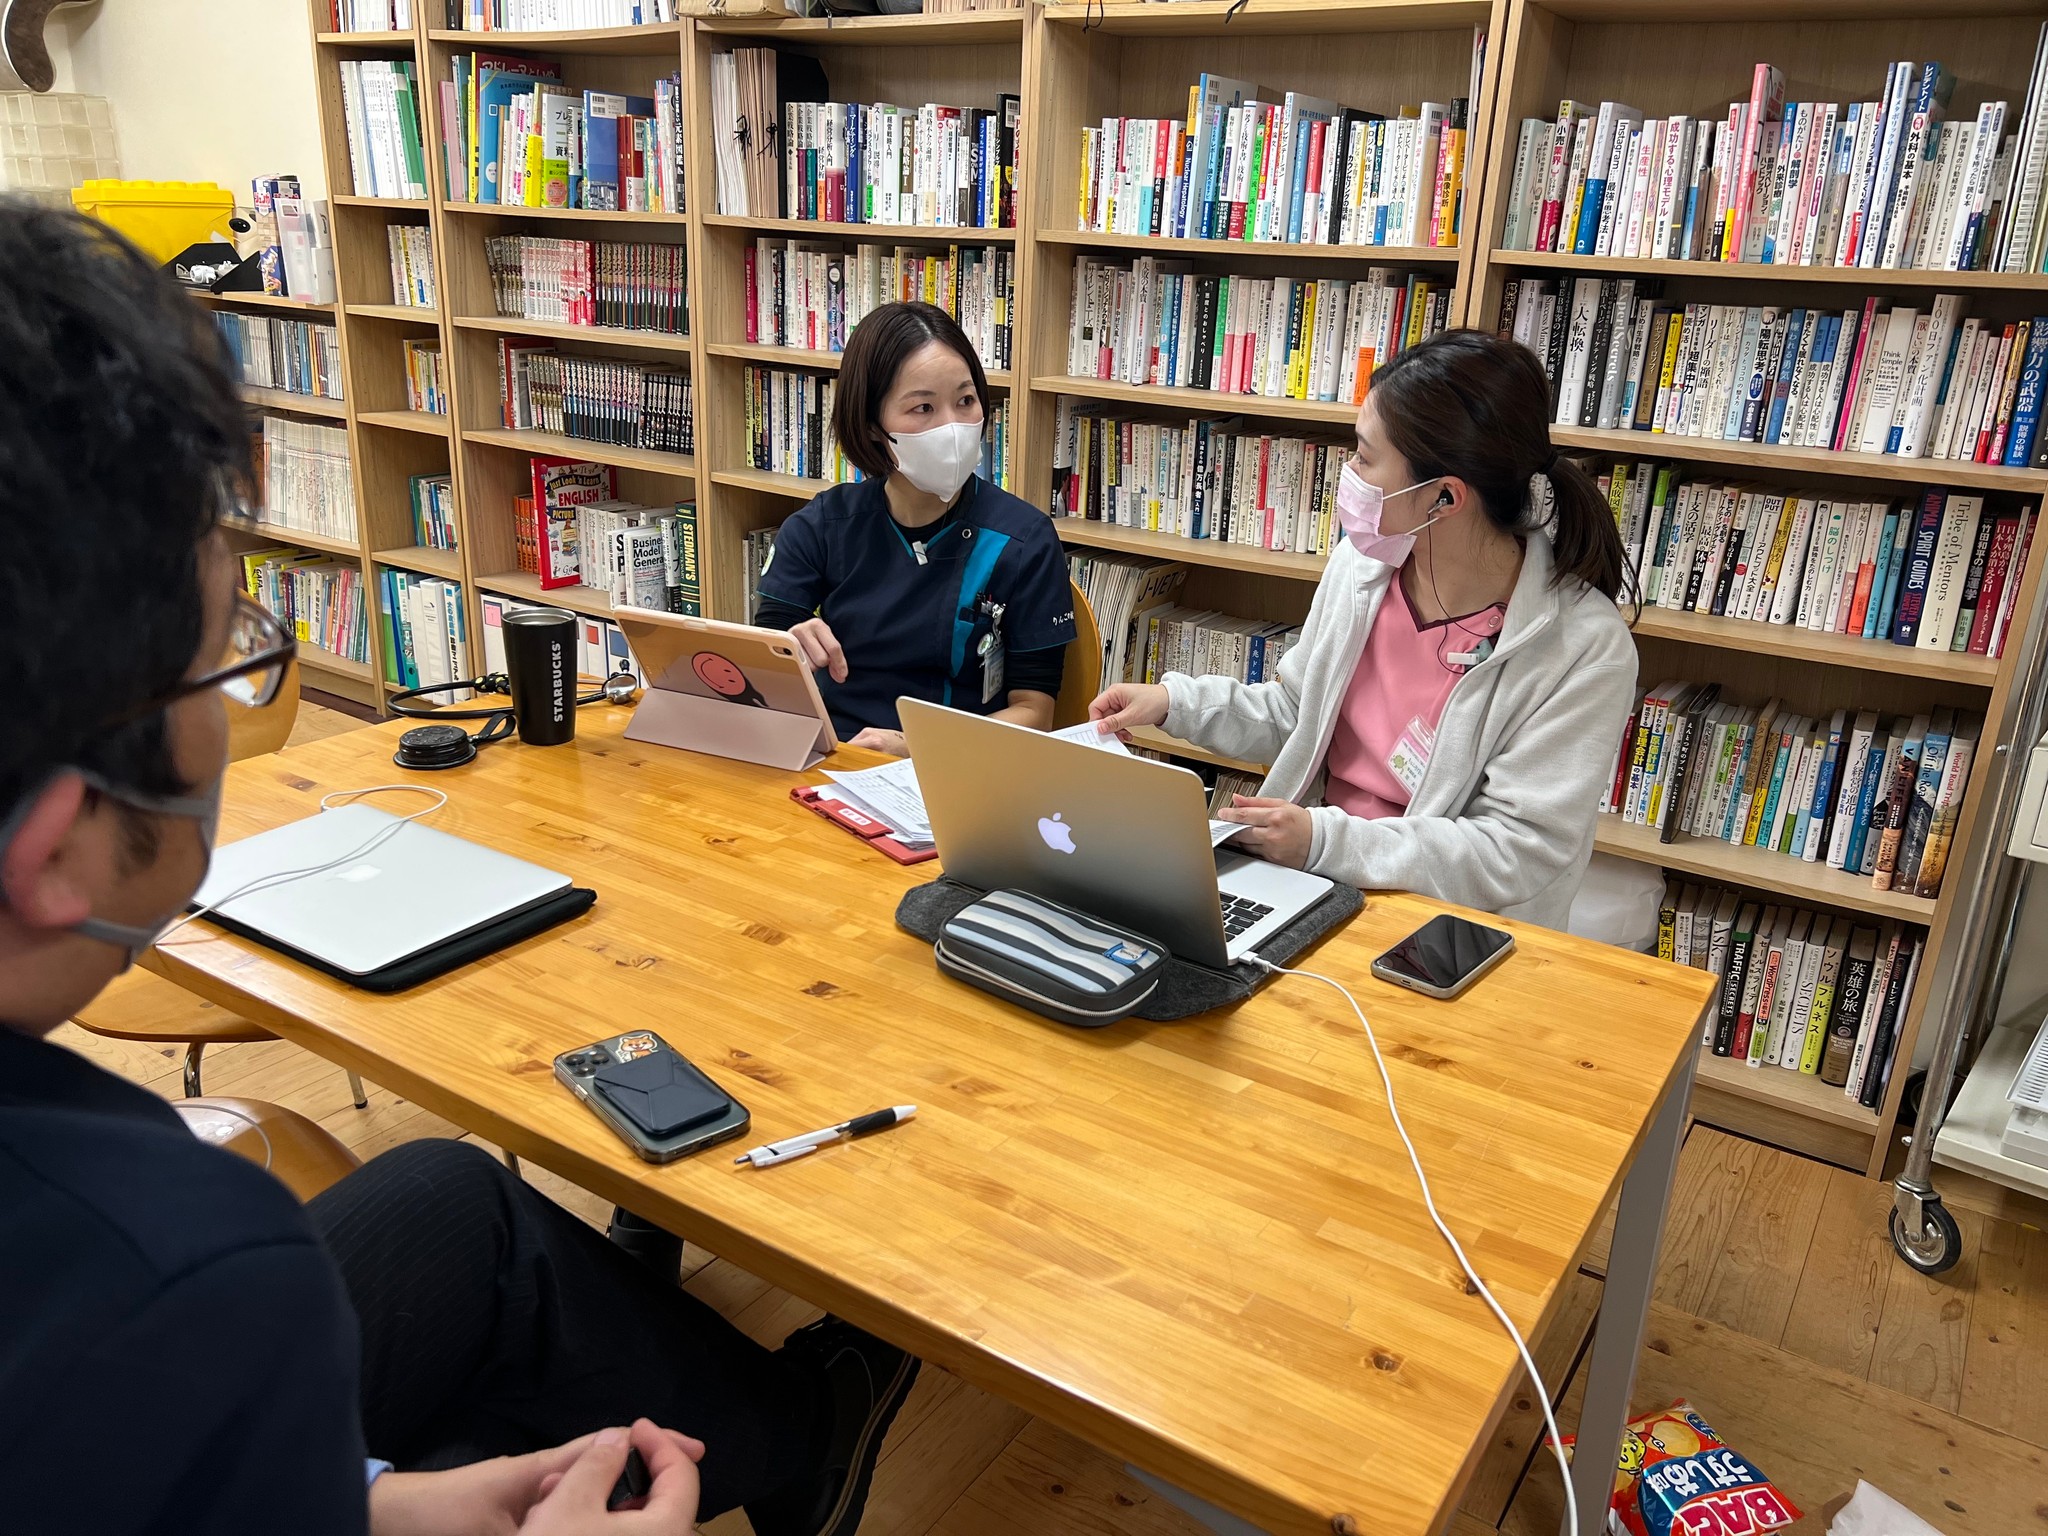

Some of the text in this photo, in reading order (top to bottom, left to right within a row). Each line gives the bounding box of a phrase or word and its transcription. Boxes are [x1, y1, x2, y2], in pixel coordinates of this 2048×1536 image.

[1918, 65, 1934, 111] レジデントノート
[1613, 122, 1629, 170] Instagram
[1638, 145, 1650, 177] 生産性
[1658, 122, 1680, 217] 成功する心理モデル
[1902, 131, 1921, 179] 外科の基本
[1179, 187, 1189, 219] Hepatology
[1328, 290, 1337, 331] 人を伸ばす力
[1570, 306, 1589, 353] 大転換
[1684, 351, 1700, 394] 超集中力
[1780, 321, 1800, 380] 嫌われる勇気
[1796, 363, 1817, 430] 成功する人は心配性
[1809, 364, 1831, 430] 成功する人は心配性
[550, 480, 561, 490] Just
[562, 477, 576, 486] Look
[583, 477, 600, 486] Learn
[558, 489, 599, 507] ENGLISH
[552, 510, 575, 519] PICTURE
[633, 546, 660, 558] Model
[682, 523, 696, 581] STEDMAN'S
[1822, 526, 1839, 574] 脳のしつけ
[1908, 494, 1942, 589] ANIMAL SPIRIT GUIDES
[1937, 501, 1971, 601] Tribe of Mentors
[1964, 524, 1993, 601] 竹田和平の強運学
[1138, 572, 1178, 602] J-VET
[552, 643, 563, 722] STARBUCKS
[1676, 722, 1693, 777] えんとつ町のプペル
[1922, 766, 1935, 778] the
[1927, 746, 1938, 764] Off
[1844, 735, 1870, 816] アメーバ経営の進化
[1941, 752, 1963, 807] World Road Trip
[1660, 929, 1672, 959] 実行力
[1726, 942, 1746, 1017] TRAFFIC SECRETS
[1841, 961, 1867, 1013] 英雄の旅
[1646, 1452, 1753, 1497] うすしお味
